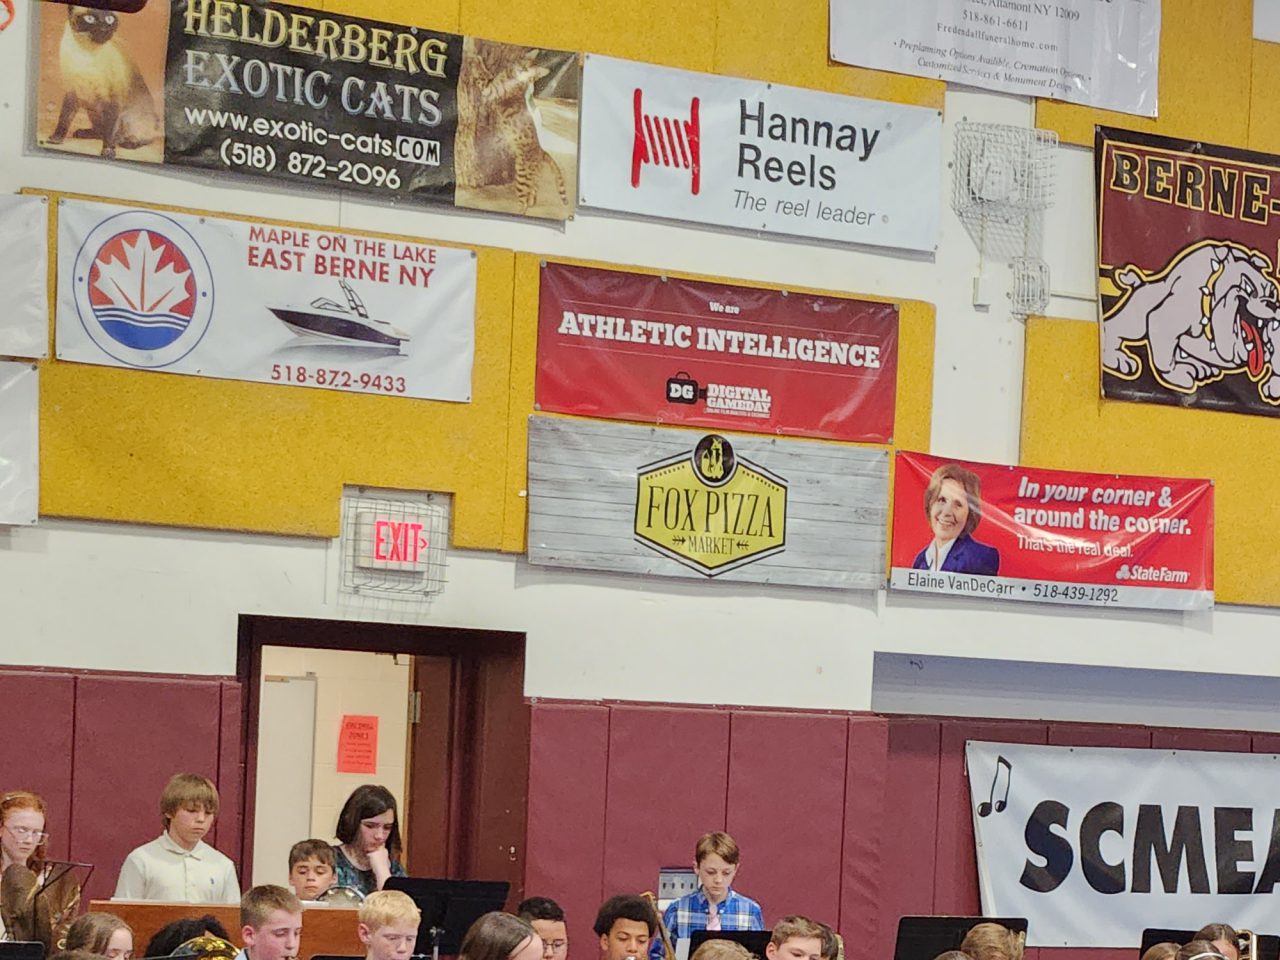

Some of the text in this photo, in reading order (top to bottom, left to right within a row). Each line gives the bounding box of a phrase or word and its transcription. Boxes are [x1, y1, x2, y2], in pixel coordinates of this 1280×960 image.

[962, 10, 1029, 31] 518-861-6611
[1033, 4, 1051, 16] NY
[1054, 6, 1080, 21] 12009
[183, 0, 450, 79] HELDERBERG
[183, 49, 443, 127] EXOTIC CATS
[739, 98, 881, 162] Hannay
[220, 138, 402, 190] (518) 872-2096
[737, 142, 838, 191] Reels
[733, 188, 876, 226] The reel leader
[248, 225, 438, 265] MAPLE ON THE LAKE
[248, 245, 435, 289] EAST BERNE NY
[709, 301, 740, 315] We are
[557, 310, 881, 369] ATHLETIC INTELLIGENCE
[270, 363, 407, 394] 518-872-9433
[669, 382, 694, 400] DG
[707, 383, 772, 403] DIGITAL
[706, 397, 771, 413] GAMEDAY
[1018, 476, 1173, 508] In your corner &
[645, 485, 776, 538] FOX PIZZA
[1013, 506, 1192, 536] around the corner.
[374, 519, 423, 563] EXIT
[687, 535, 736, 555] MARKET
[1016, 533, 1134, 559] That's the real deal.
[908, 571, 1119, 604] Elaine VanDeCarr 518-439-1292
